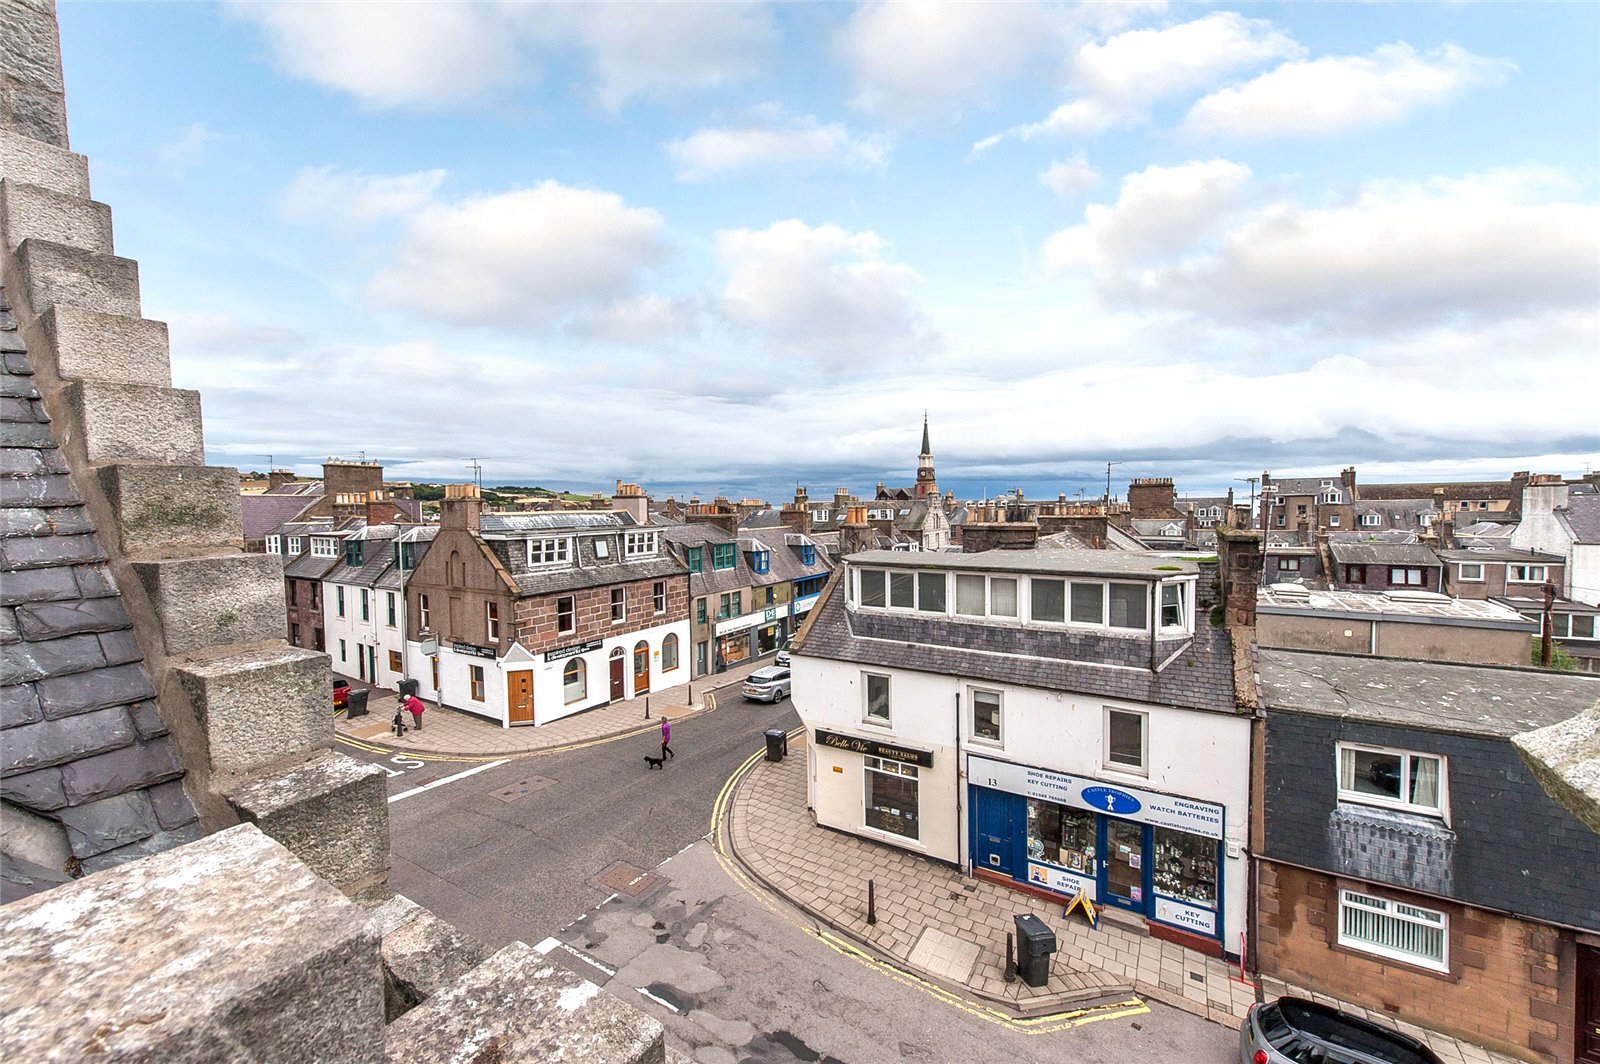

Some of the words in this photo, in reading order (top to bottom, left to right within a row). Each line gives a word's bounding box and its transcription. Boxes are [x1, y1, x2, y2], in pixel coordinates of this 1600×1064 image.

[825, 734, 849, 749] Belle
[851, 739, 871, 753] Vie
[988, 777, 998, 787] 13
[1027, 770, 1043, 779] SHOE
[1044, 774, 1072, 784] REPAIRS
[1040, 781, 1068, 792] CUTTING
[1107, 788, 1135, 802] TROPHIES
[1149, 804, 1176, 815] WATCH
[1177, 810, 1219, 824] BATTERIES
[1174, 801, 1220, 815] ENGRAVING
[1144, 817, 1219, 838] www.castletrophies.co.uk
[1057, 881, 1082, 892] REPAIR
[1062, 876, 1080, 886] SHOE
[1184, 909, 1200, 919] KEY
[1174, 914, 1211, 929] CUTTING
